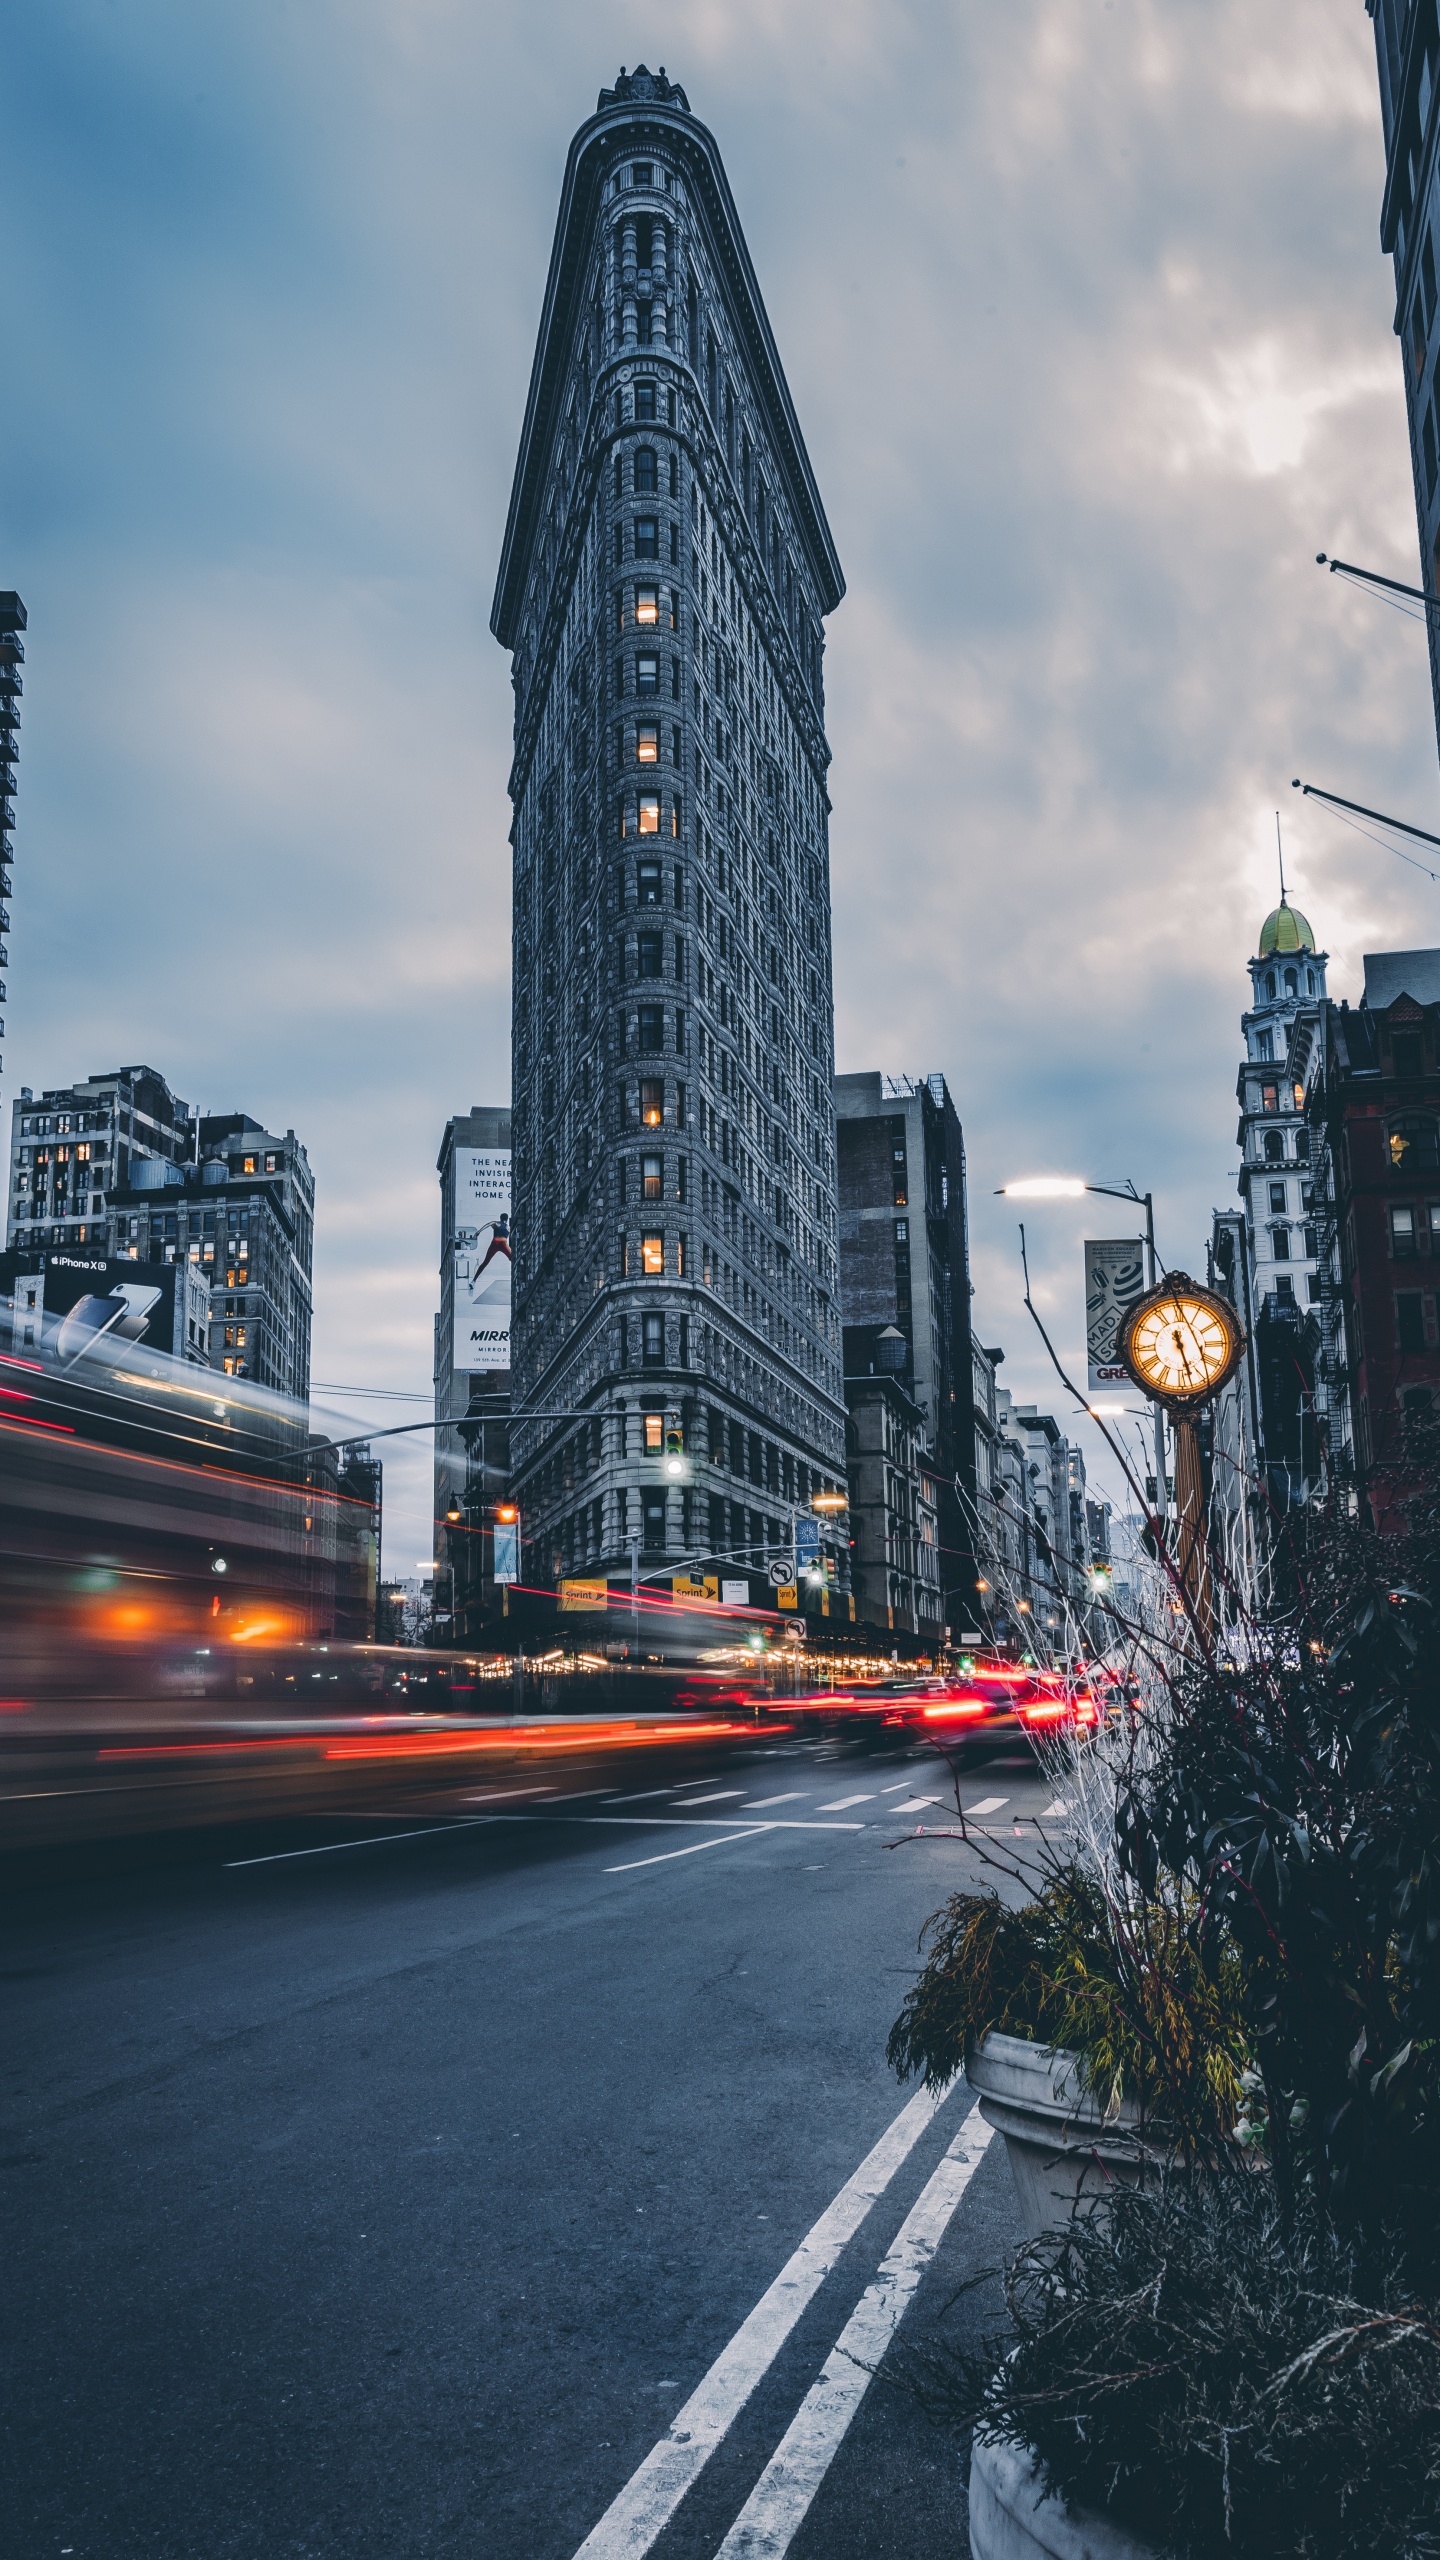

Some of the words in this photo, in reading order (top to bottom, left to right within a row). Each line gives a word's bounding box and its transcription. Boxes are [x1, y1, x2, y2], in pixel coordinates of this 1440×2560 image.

[472, 1158, 490, 1166] THE
[469, 1180, 511, 1188] INTERAC
[475, 1191, 503, 1199] HOME
[59, 1256, 89, 1269] iPhone
[470, 1330, 509, 1341] MIRR
[1087, 1316, 1120, 1346] MAD.
[1096, 1367, 1129, 1379] GRE
[566, 1591, 592, 1601] Sprint
[676, 1588, 703, 1599] Sprint
